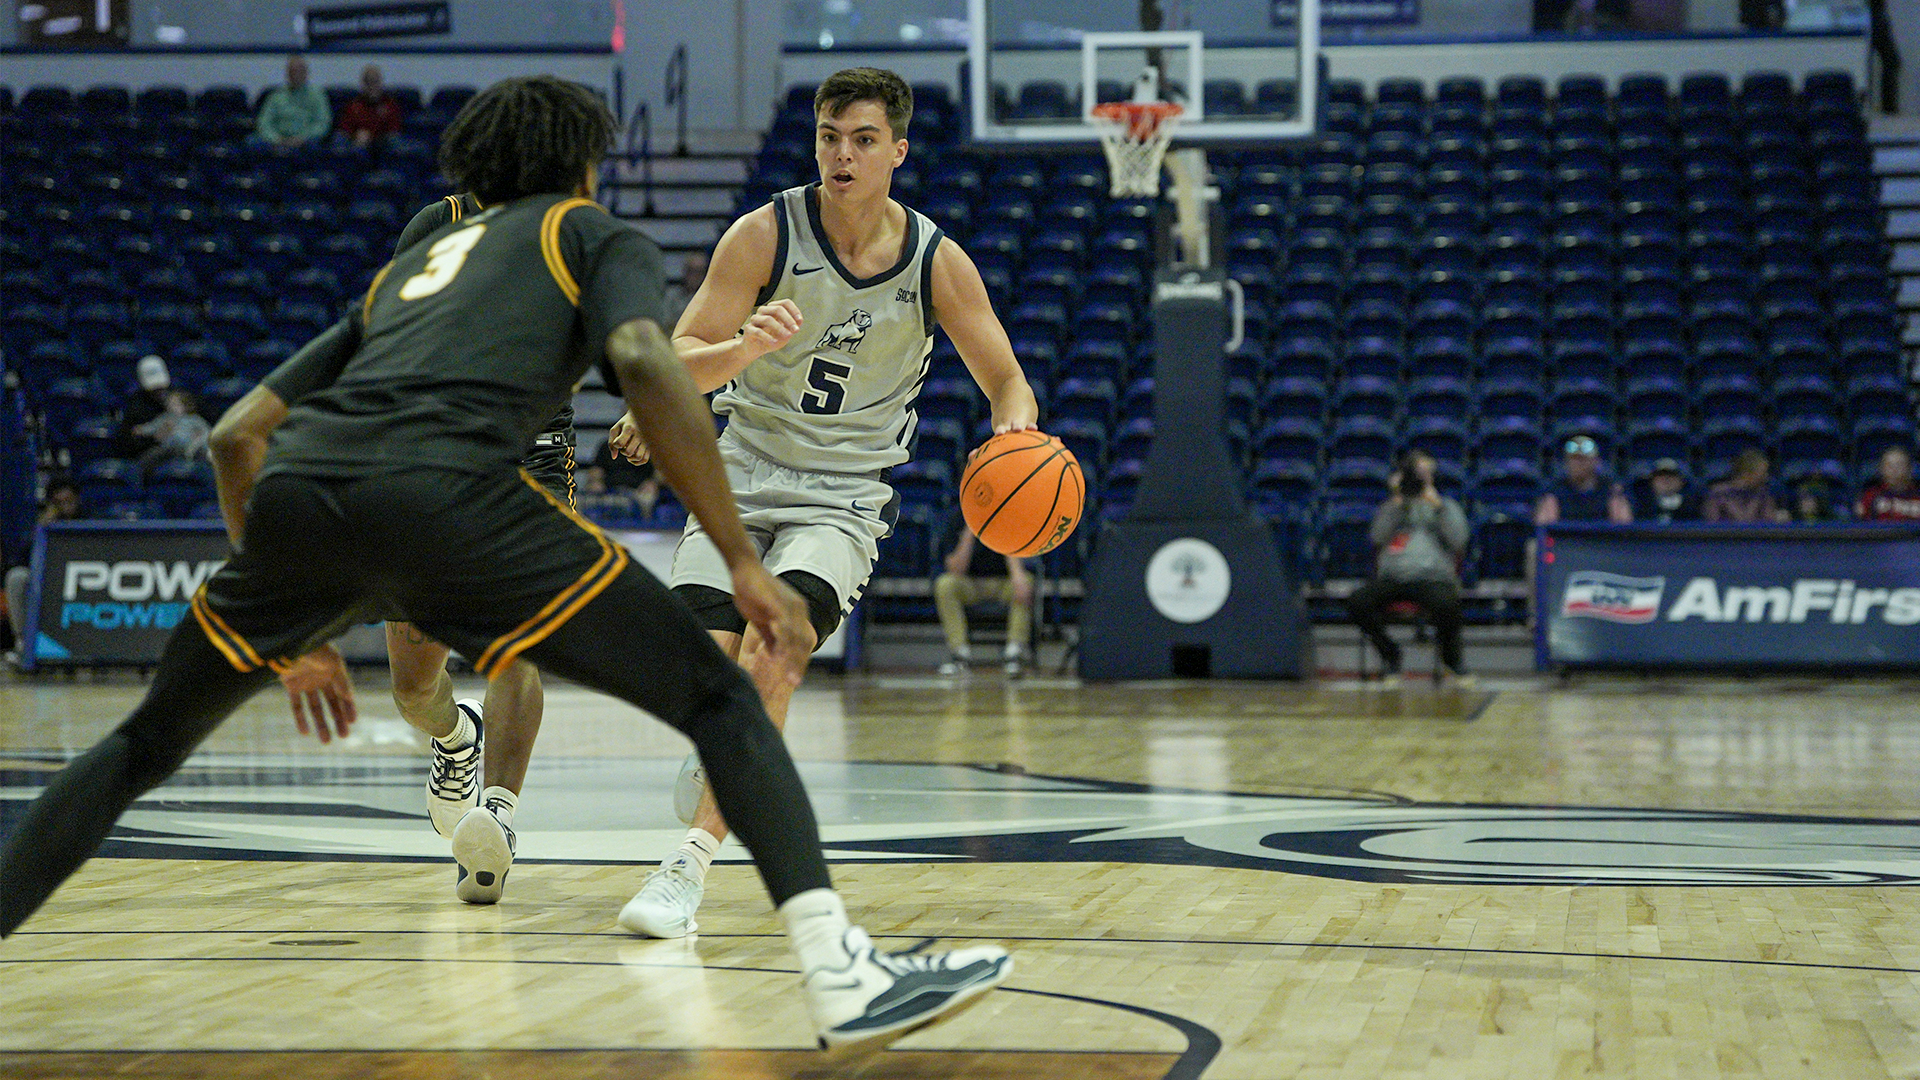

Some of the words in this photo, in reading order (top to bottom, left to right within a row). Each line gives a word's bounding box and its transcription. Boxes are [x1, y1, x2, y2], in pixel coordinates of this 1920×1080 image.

[399, 222, 488, 301] 3
[799, 355, 853, 414] 5
[61, 602, 191, 629] POWE
[1667, 576, 1920, 625] AmFirs
